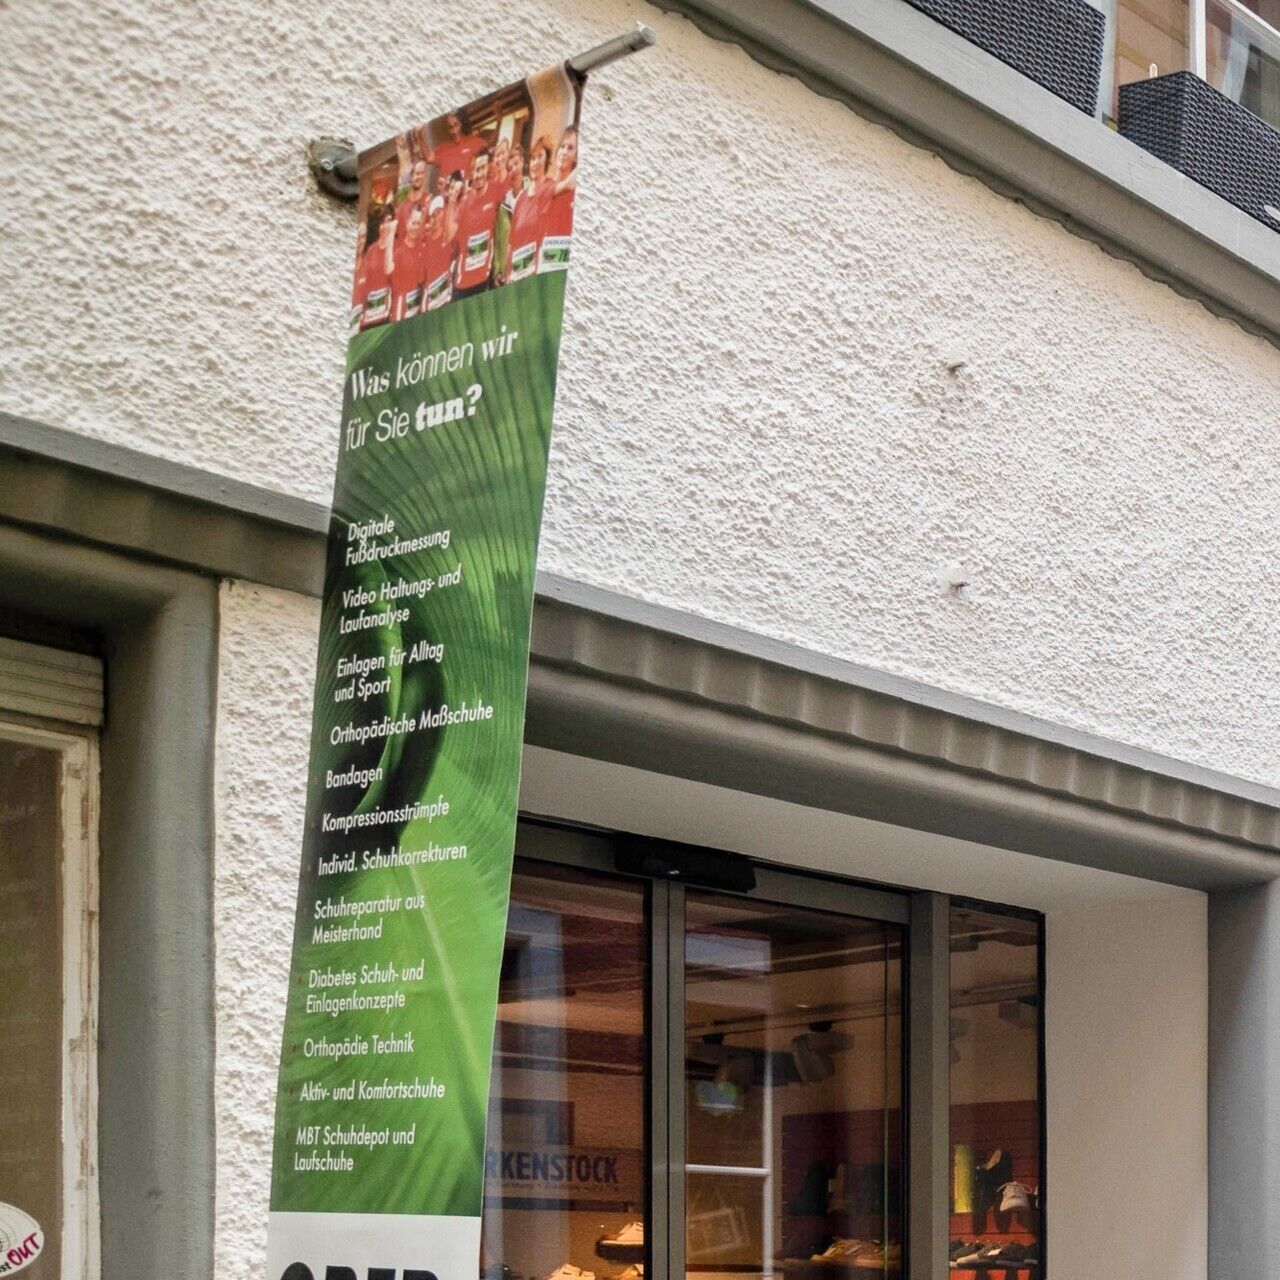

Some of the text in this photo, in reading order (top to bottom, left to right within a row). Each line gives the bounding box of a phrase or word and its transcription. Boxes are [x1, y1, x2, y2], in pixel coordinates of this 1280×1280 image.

[350, 325, 518, 400] Was können wir
[346, 383, 483, 451] für Sie tun?
[348, 515, 395, 547] Digitale
[345, 529, 451, 567] Fußdruckmessung
[342, 564, 461, 610] Video Haltungs- und
[340, 606, 410, 634] Laufanalyse
[337, 640, 444, 678] Einlagen für Alltag
[335, 677, 391, 702] und Sport
[330, 700, 493, 745] Orthopädische Maßschuhe
[326, 764, 383, 789] Bandagen
[322, 795, 449, 835] Kompressionsstrümpfe
[318, 841, 467, 876] Individ. Schuhkorrekturen
[314, 894, 425, 920] Schuhreparatur aus
[312, 918, 383, 945] Meisterhand
[309, 959, 424, 988] Diabetes Schuh- und
[306, 990, 406, 1017] Einlagenkonzepte
[304, 1031, 414, 1061] Orthopädie Technik
[300, 1077, 445, 1102] Aktiv- und Komfortschuhe
[296, 1123, 415, 1151] MBT Schuhdepot und
[294, 1151, 354, 1171] Laufschuhe
